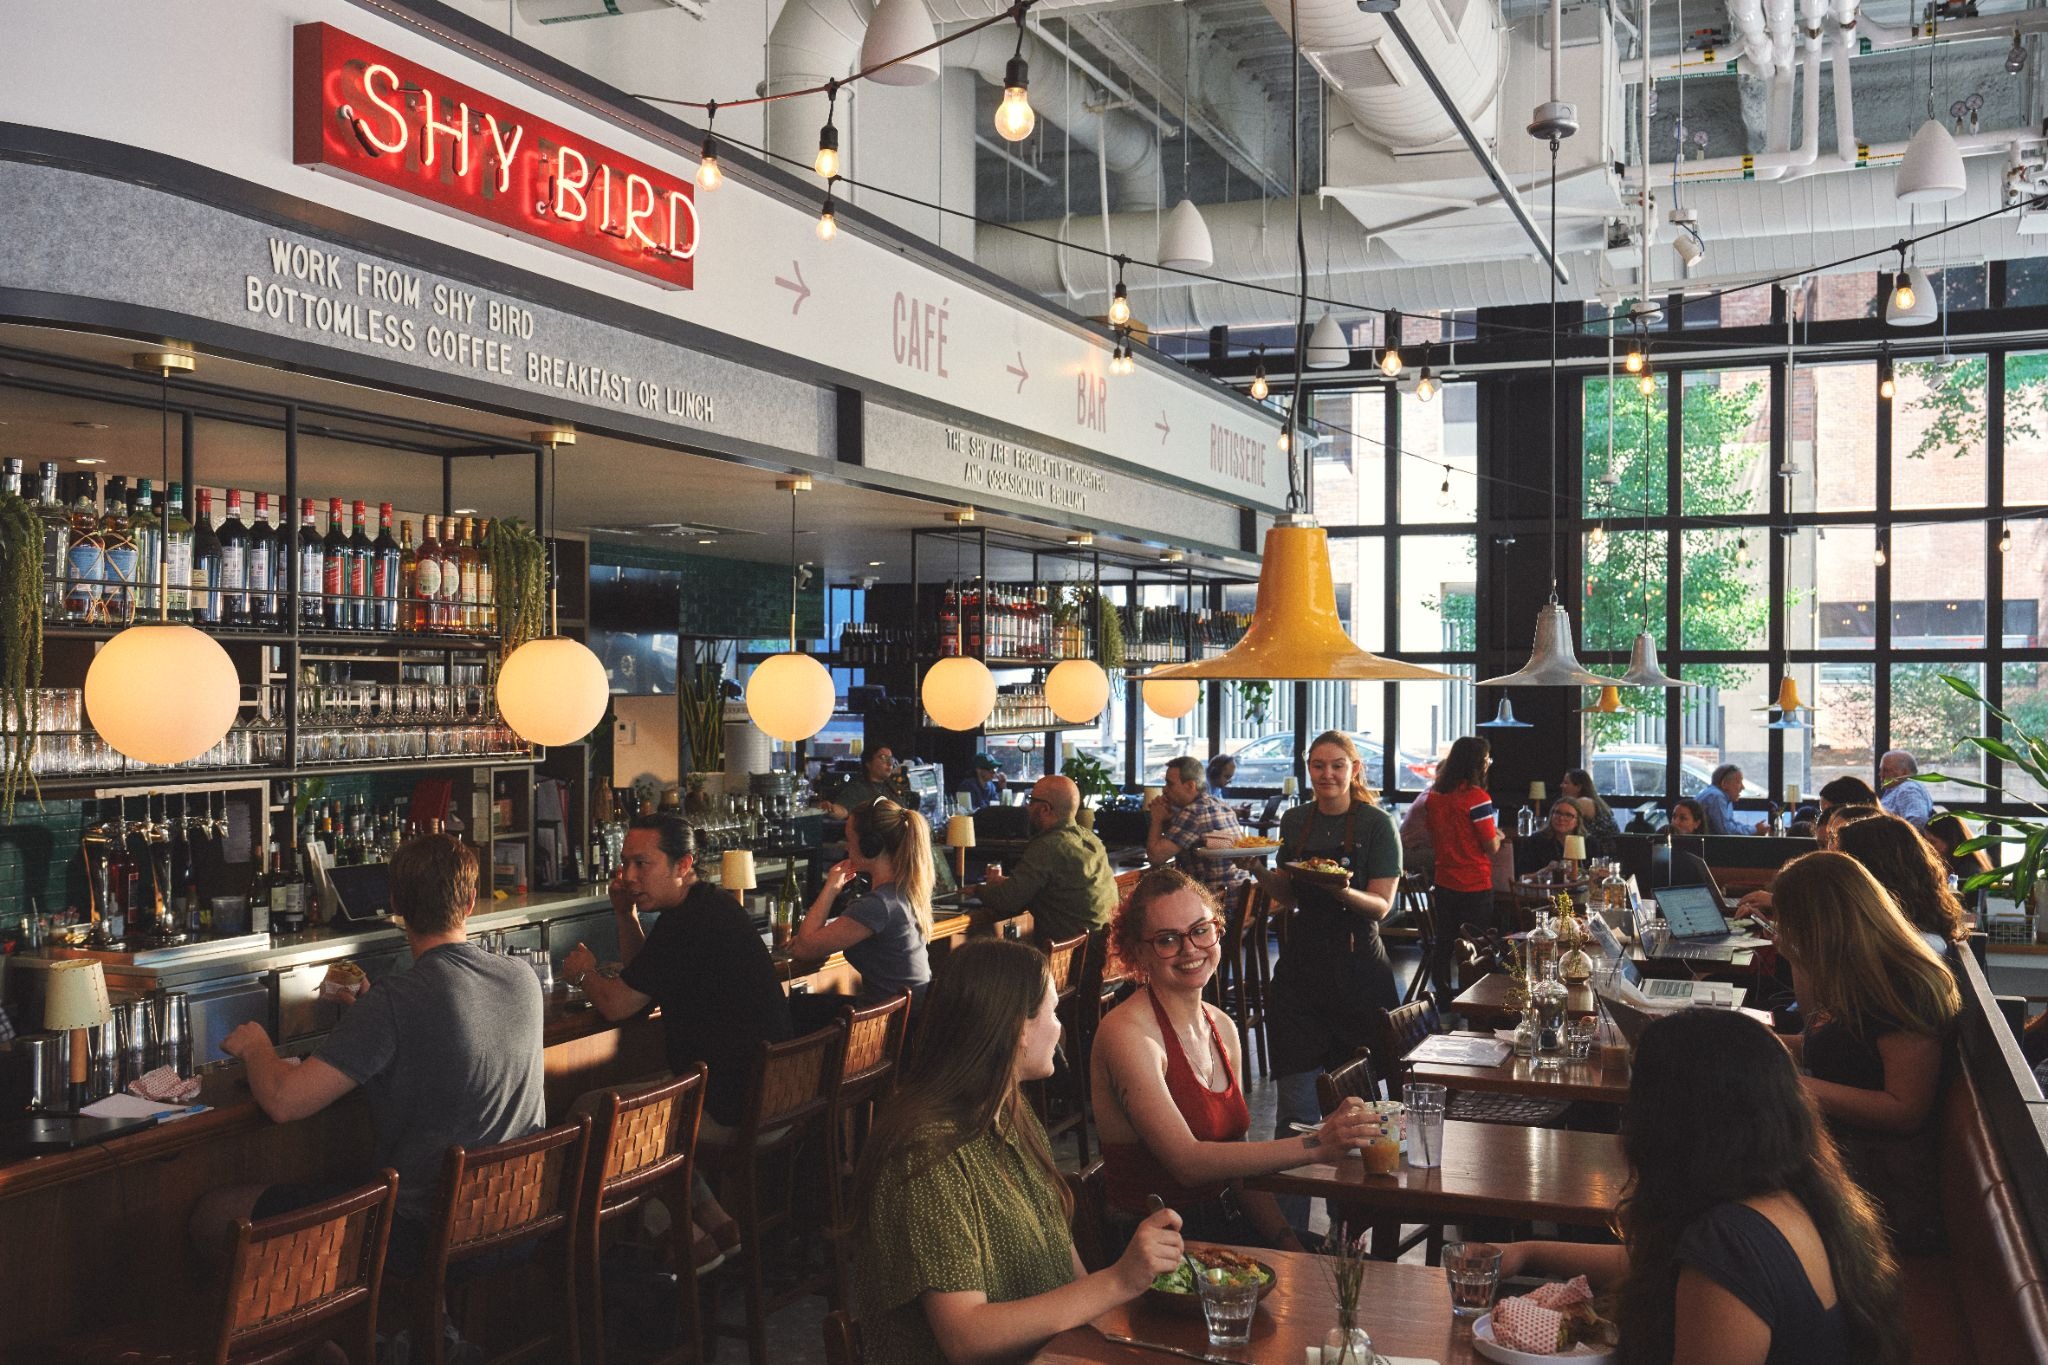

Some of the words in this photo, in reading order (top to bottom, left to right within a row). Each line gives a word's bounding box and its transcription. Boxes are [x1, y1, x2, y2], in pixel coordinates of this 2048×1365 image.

[350, 64, 524, 193] SHY
[551, 145, 700, 260] BIRD
[268, 237, 342, 290] WORK
[355, 262, 420, 309] FROM
[433, 282, 477, 326] SHY
[487, 299, 534, 340] BIRD
[245, 275, 417, 352] BOTTOMLESS
[426, 326, 513, 375] COFFEE
[526, 352, 631, 405] BREAKFAST
[637, 379, 660, 408] OR
[666, 386, 715, 423] LUNCH
[892, 291, 950, 379] CAFÉ
[1076, 371, 1108, 434] BAR
[945, 428, 966, 454] THE
[968, 436, 989, 460] SHY
[991, 443, 1010, 465] ARE
[1013, 448, 1063, 480] FREQUENTLY
[964, 462, 984, 485] AND
[987, 469, 1046, 500] OCCASIONALLY
[1050, 483, 1088, 511] BRILLIANT
[1210, 422, 1267, 488] ROTISSERIE
